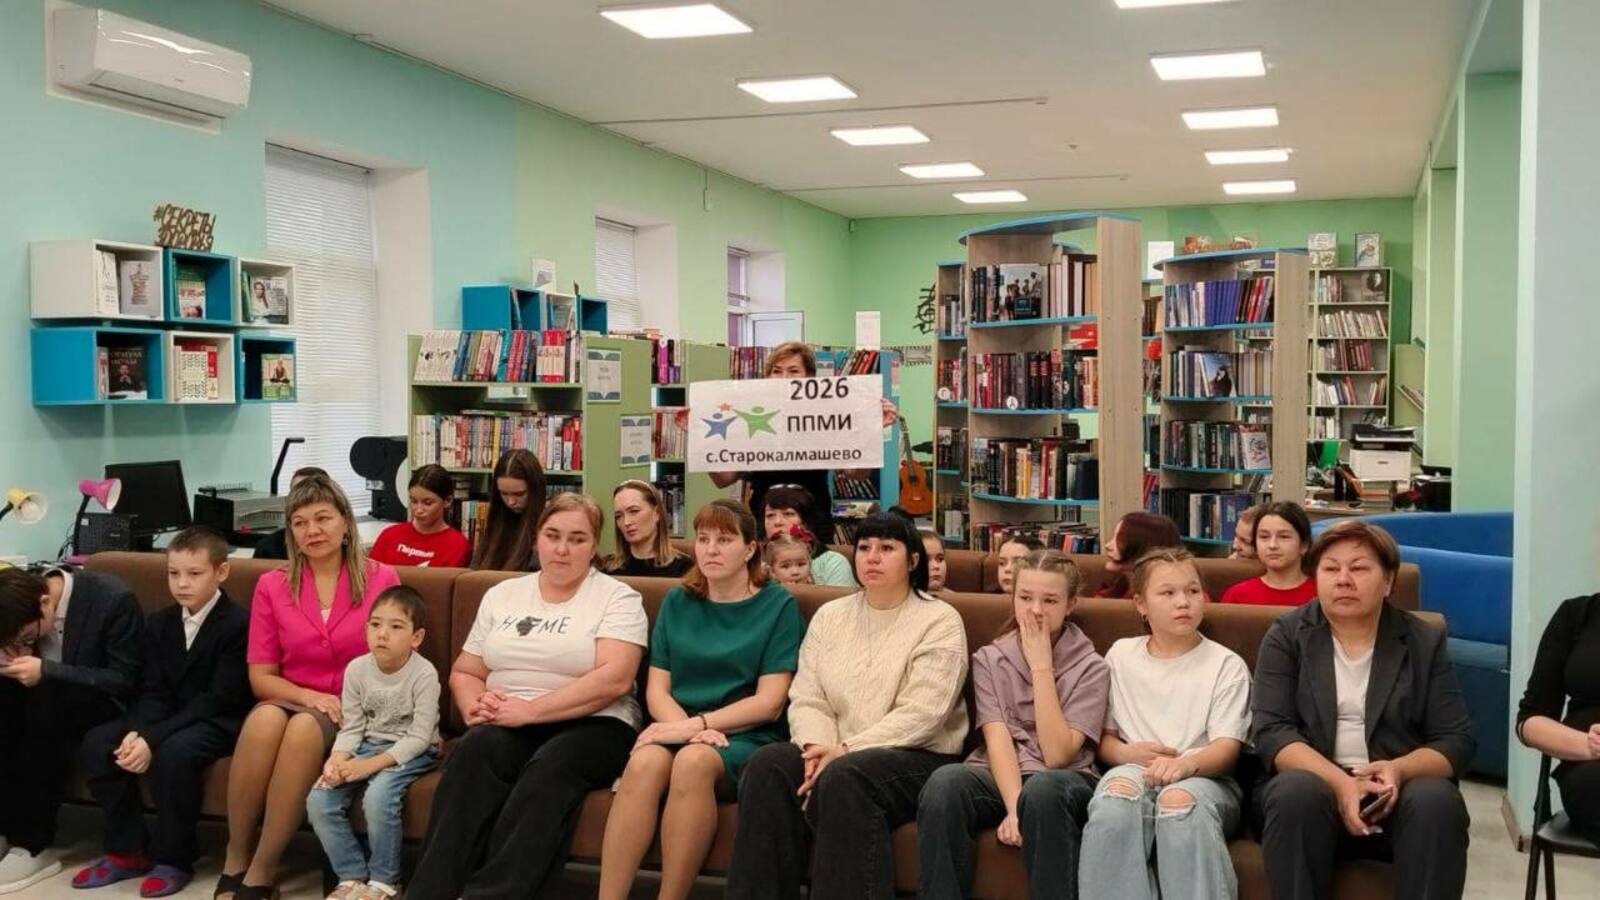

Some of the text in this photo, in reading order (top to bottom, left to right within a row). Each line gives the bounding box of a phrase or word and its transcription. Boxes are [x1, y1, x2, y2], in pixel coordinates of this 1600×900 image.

[790, 377, 849, 401] 2026
[786, 413, 852, 433] ППМИ
[705, 448, 862, 465] с.Старокалмашево
